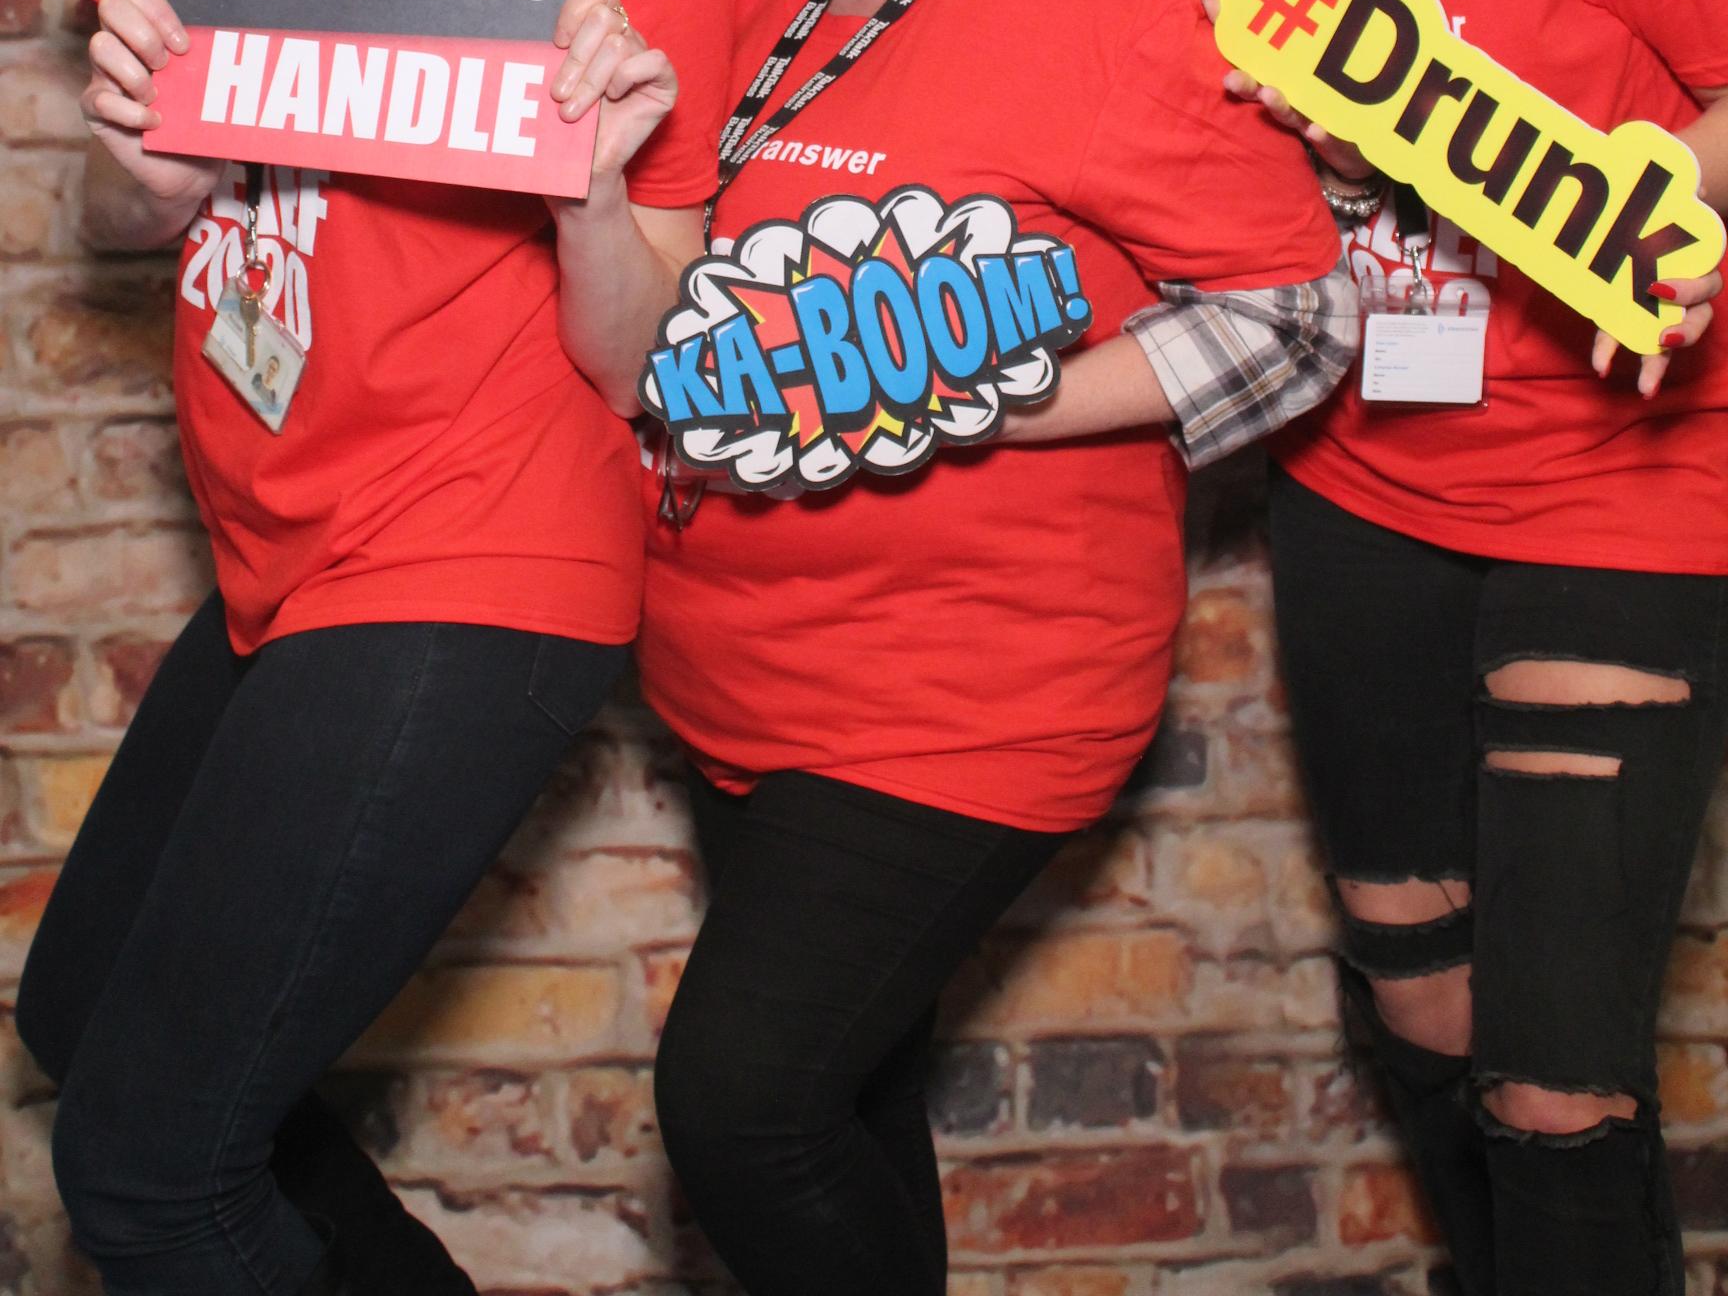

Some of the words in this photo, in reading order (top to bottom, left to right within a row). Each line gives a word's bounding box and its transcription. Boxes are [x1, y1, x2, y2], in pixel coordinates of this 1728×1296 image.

[839, 18, 878, 56] Business
[847, 21, 890, 59] TalkTalk
[200, 30, 545, 157] HANDLE
[746, 56, 778, 98] Business
[756, 57, 791, 99] TalkTalk
[651, 247, 1089, 422] KA-BOOM!
